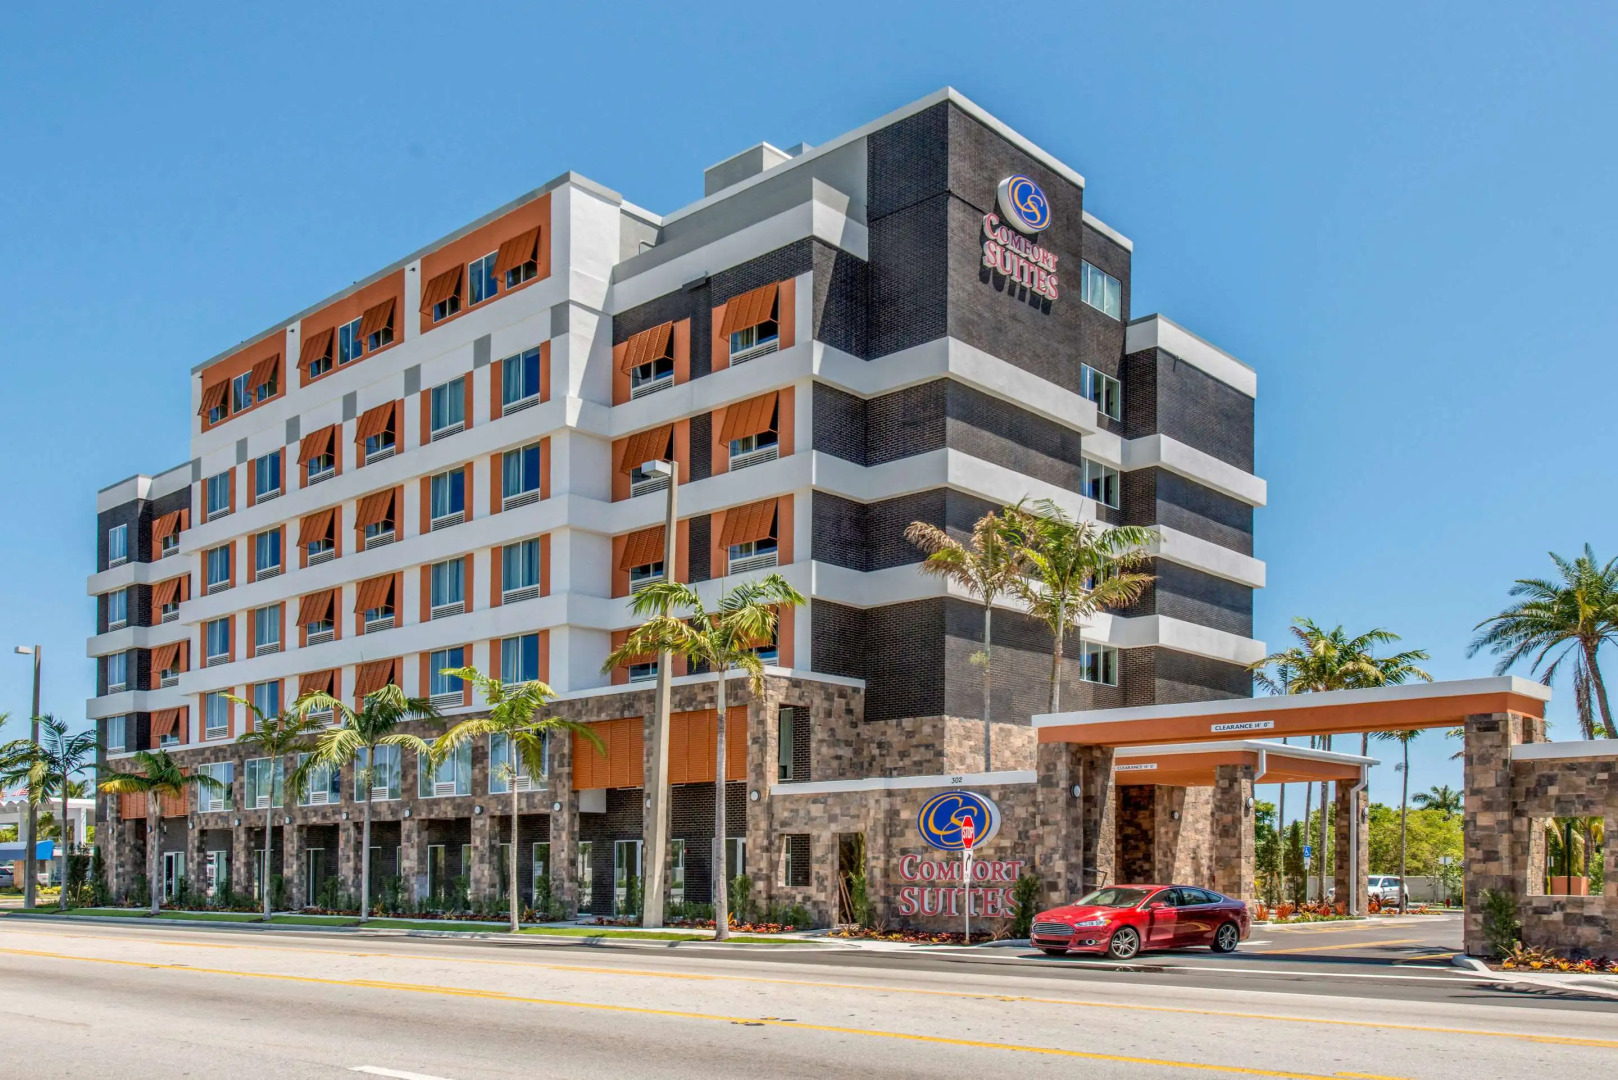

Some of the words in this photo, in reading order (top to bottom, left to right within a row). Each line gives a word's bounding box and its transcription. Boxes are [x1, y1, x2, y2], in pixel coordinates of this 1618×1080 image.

[983, 213, 1058, 272] COMFORT
[983, 240, 1058, 300] SUITES
[1214, 723, 1252, 731] CLEARANCE
[951, 776, 963, 784] 302
[962, 826, 974, 839] STOP
